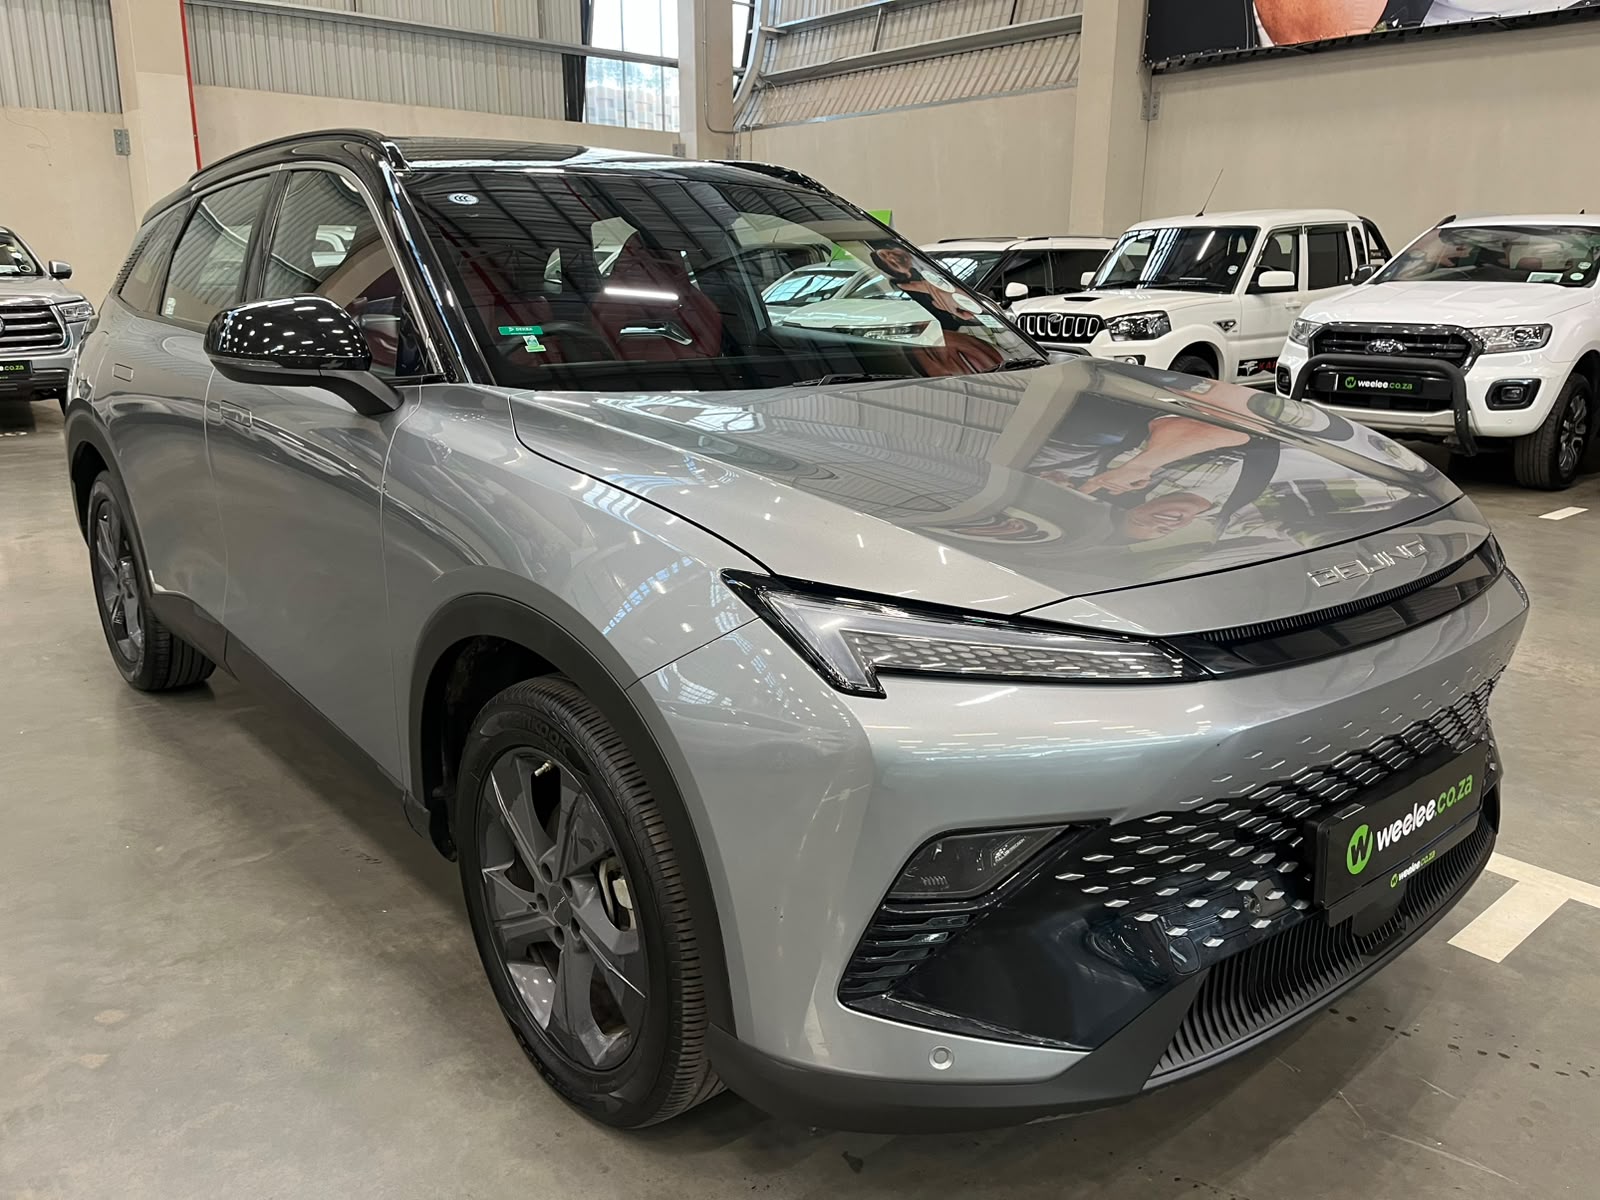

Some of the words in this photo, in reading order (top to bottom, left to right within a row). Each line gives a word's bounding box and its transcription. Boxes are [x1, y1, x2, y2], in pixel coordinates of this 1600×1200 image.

[1357, 379, 1413, 390] weelee.co.za
[1307, 540, 1427, 587] BEIJING
[1376, 774, 1473, 852] weelee.co.za
[1398, 850, 1436, 882] weelee.co.za
